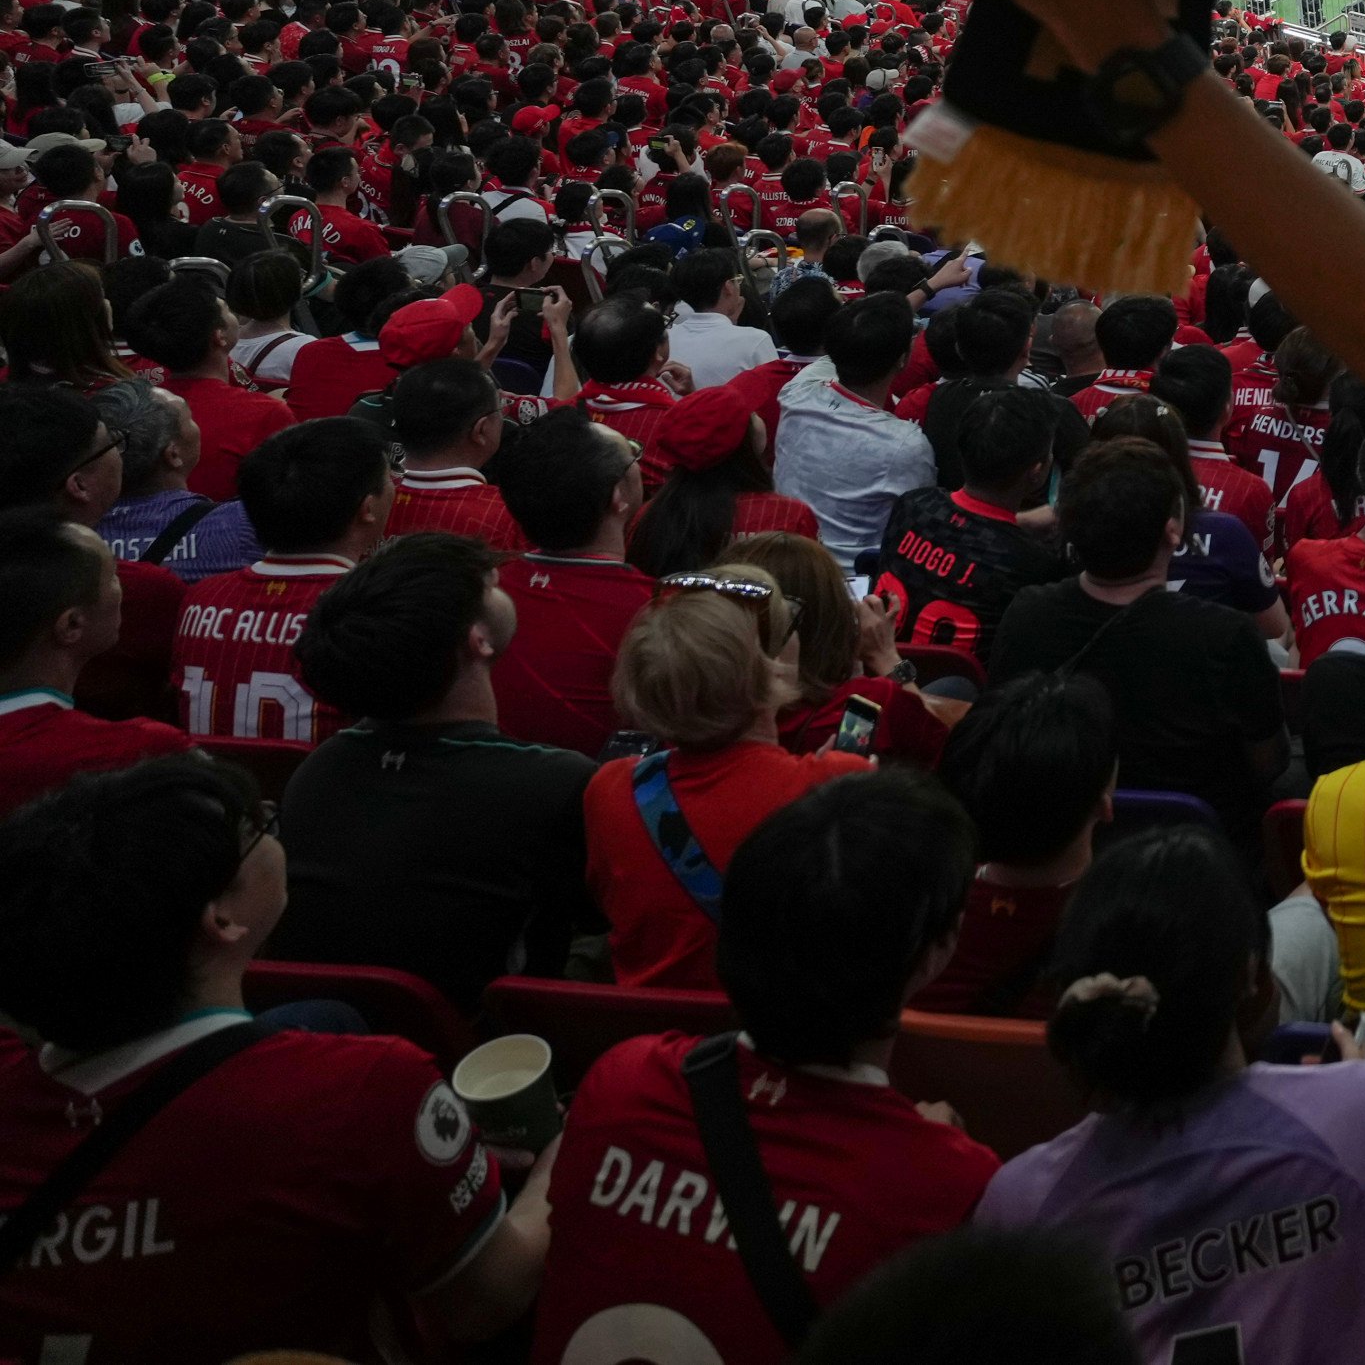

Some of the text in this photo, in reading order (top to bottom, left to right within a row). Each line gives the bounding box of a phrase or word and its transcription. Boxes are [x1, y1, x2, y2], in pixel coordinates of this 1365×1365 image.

[762, 192, 788, 202] ALLISTE
[885, 216, 909, 226] ELLIOT
[1251, 414, 1325, 446] HENDERS
[898, 530, 975, 588] DIOGO J.
[180, 604, 309, 647] MAC ALLIS
[28, 1197, 176, 1268] RGIL
[1115, 1194, 1340, 1311] BECKER
